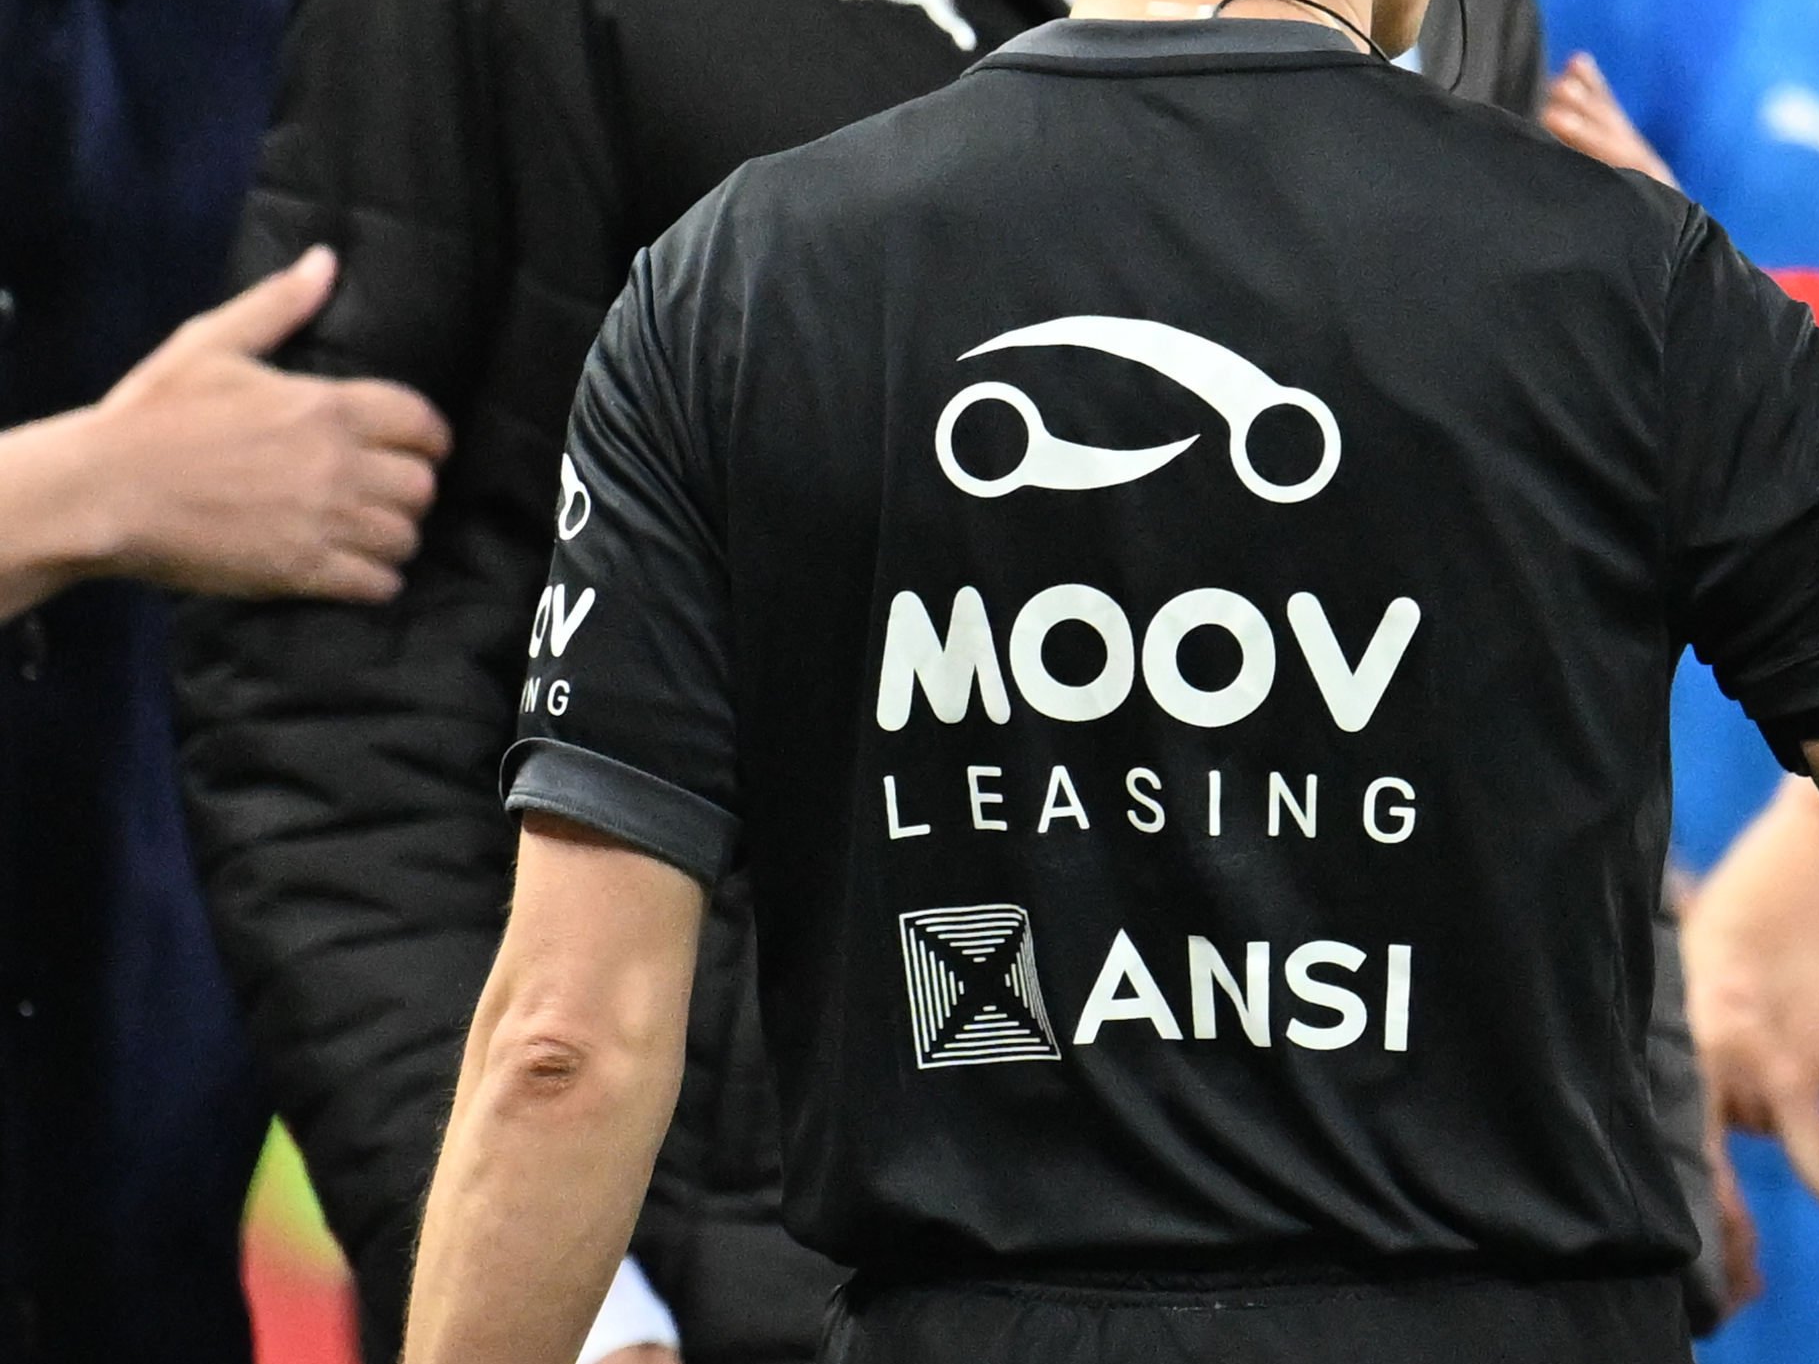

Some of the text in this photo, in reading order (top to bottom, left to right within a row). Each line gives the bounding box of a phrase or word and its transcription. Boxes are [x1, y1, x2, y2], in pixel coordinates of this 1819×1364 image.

[877, 583, 1421, 732] MOOV
[883, 765, 1416, 843] LEASING
[1073, 928, 1412, 1051] ANSI
